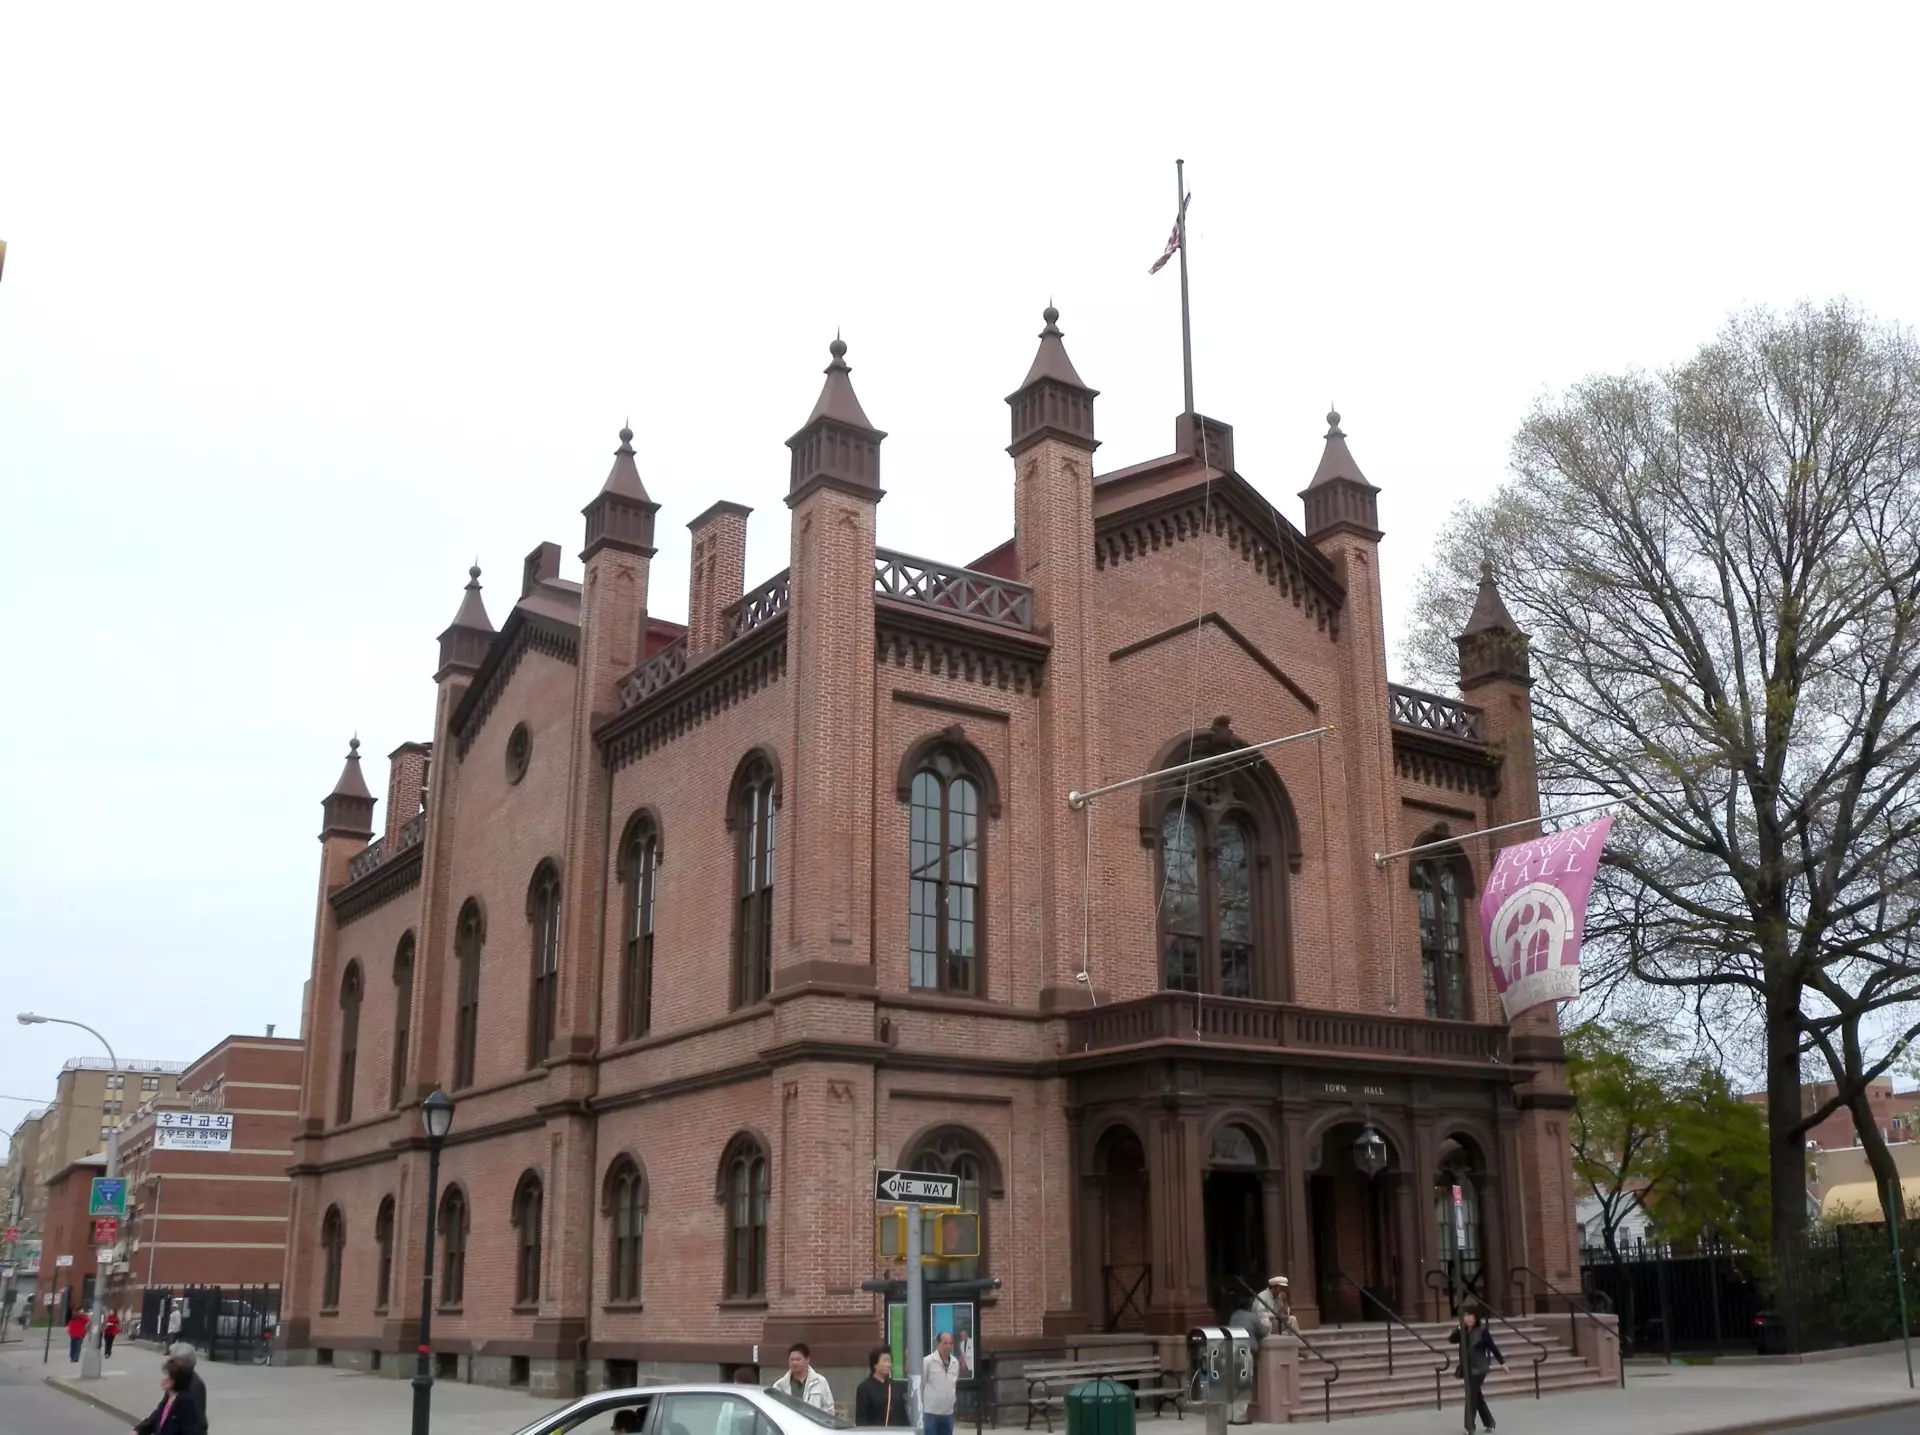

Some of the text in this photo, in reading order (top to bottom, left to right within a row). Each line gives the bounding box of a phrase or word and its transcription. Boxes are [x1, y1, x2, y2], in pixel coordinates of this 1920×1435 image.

[1496, 834, 1592, 873] TOWN
[1489, 853, 1582, 894] HALL
[1325, 1083, 1384, 1096] TOWN HALL
[161, 1113, 229, 1128] 우리교회
[889, 1180, 947, 1196] ONE WAY
